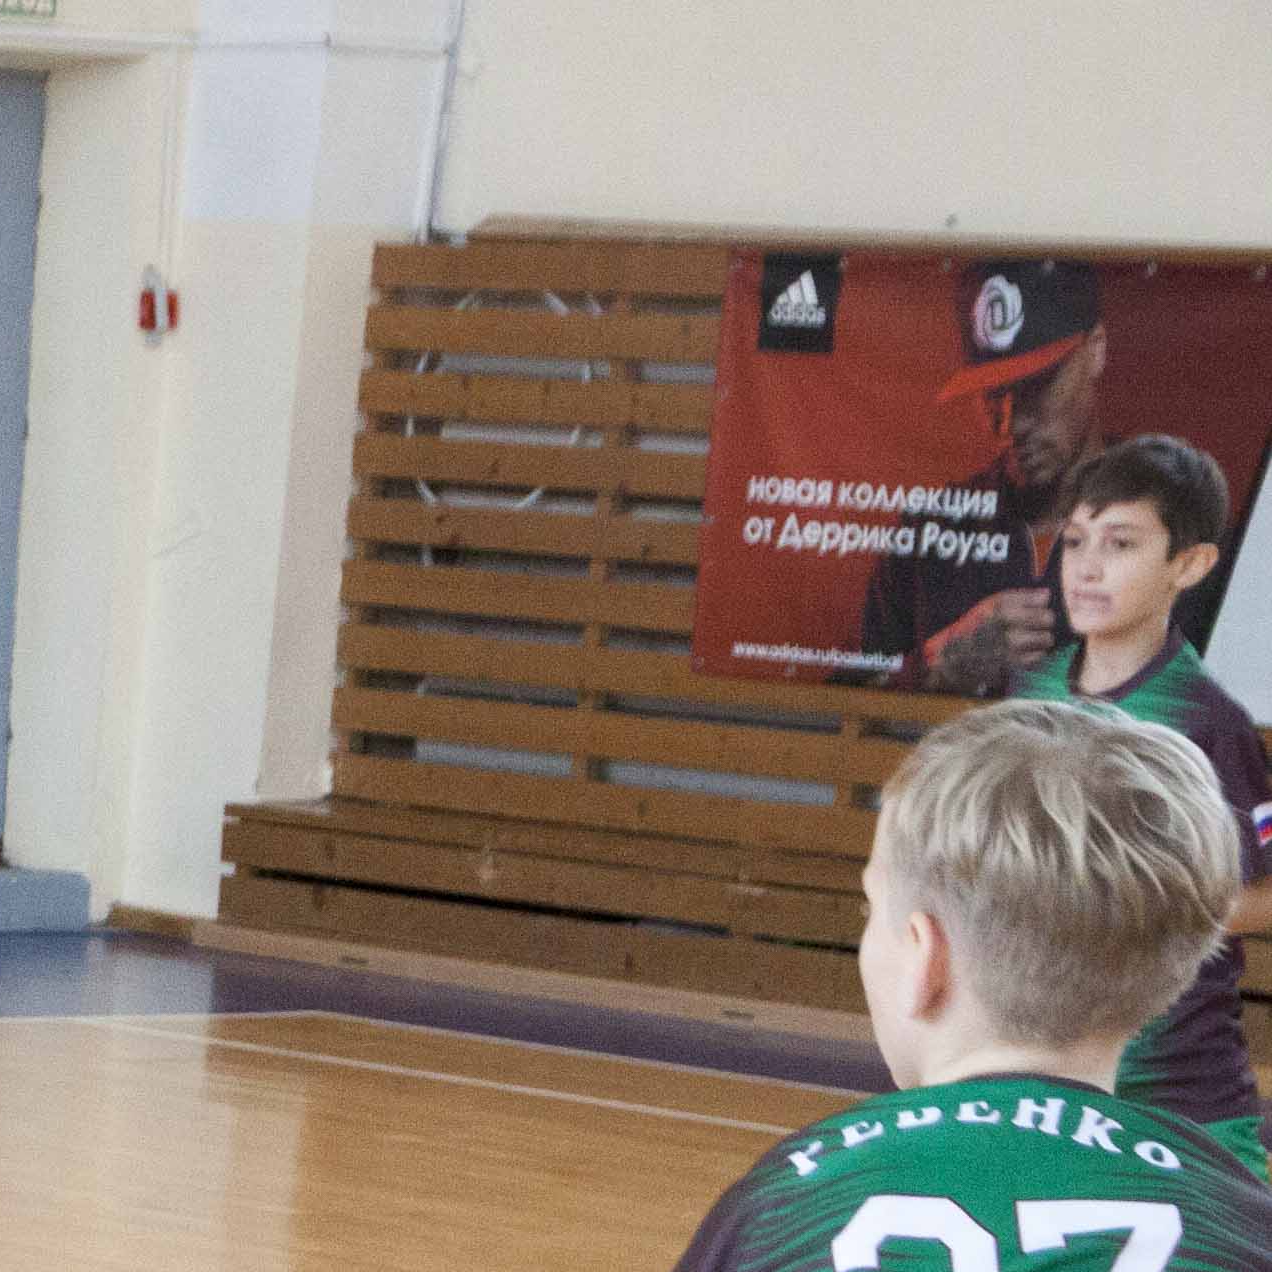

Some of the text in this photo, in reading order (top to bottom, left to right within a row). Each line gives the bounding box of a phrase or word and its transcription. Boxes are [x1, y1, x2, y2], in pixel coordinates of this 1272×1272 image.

[767, 302, 826, 328] adidas
[838, 481, 998, 520] коллекция
[742, 512, 1009, 565] от Деррика Роуза
